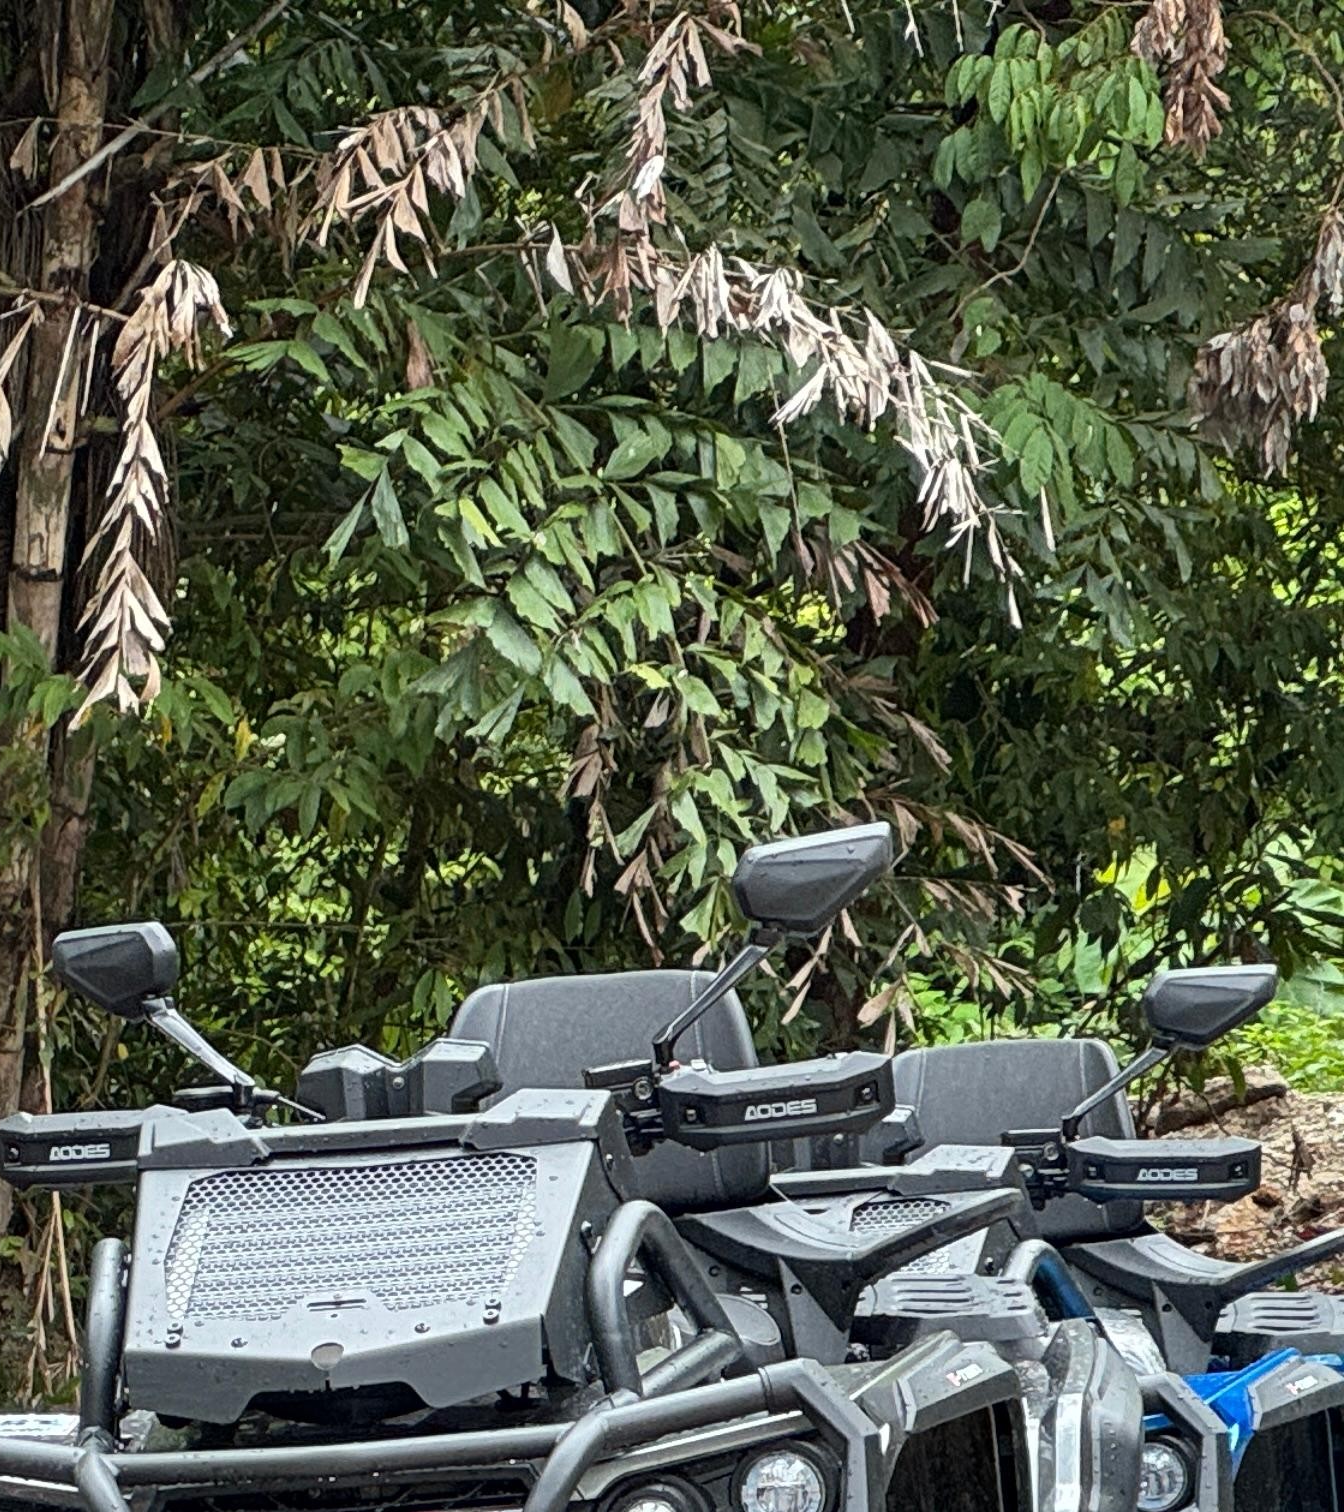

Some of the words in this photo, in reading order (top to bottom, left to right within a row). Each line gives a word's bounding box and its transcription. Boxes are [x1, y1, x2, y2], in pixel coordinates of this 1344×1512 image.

[744, 1098, 818, 1121] AODES
[49, 1143, 111, 1161] AODES
[1137, 1168, 1199, 1181] AODES
